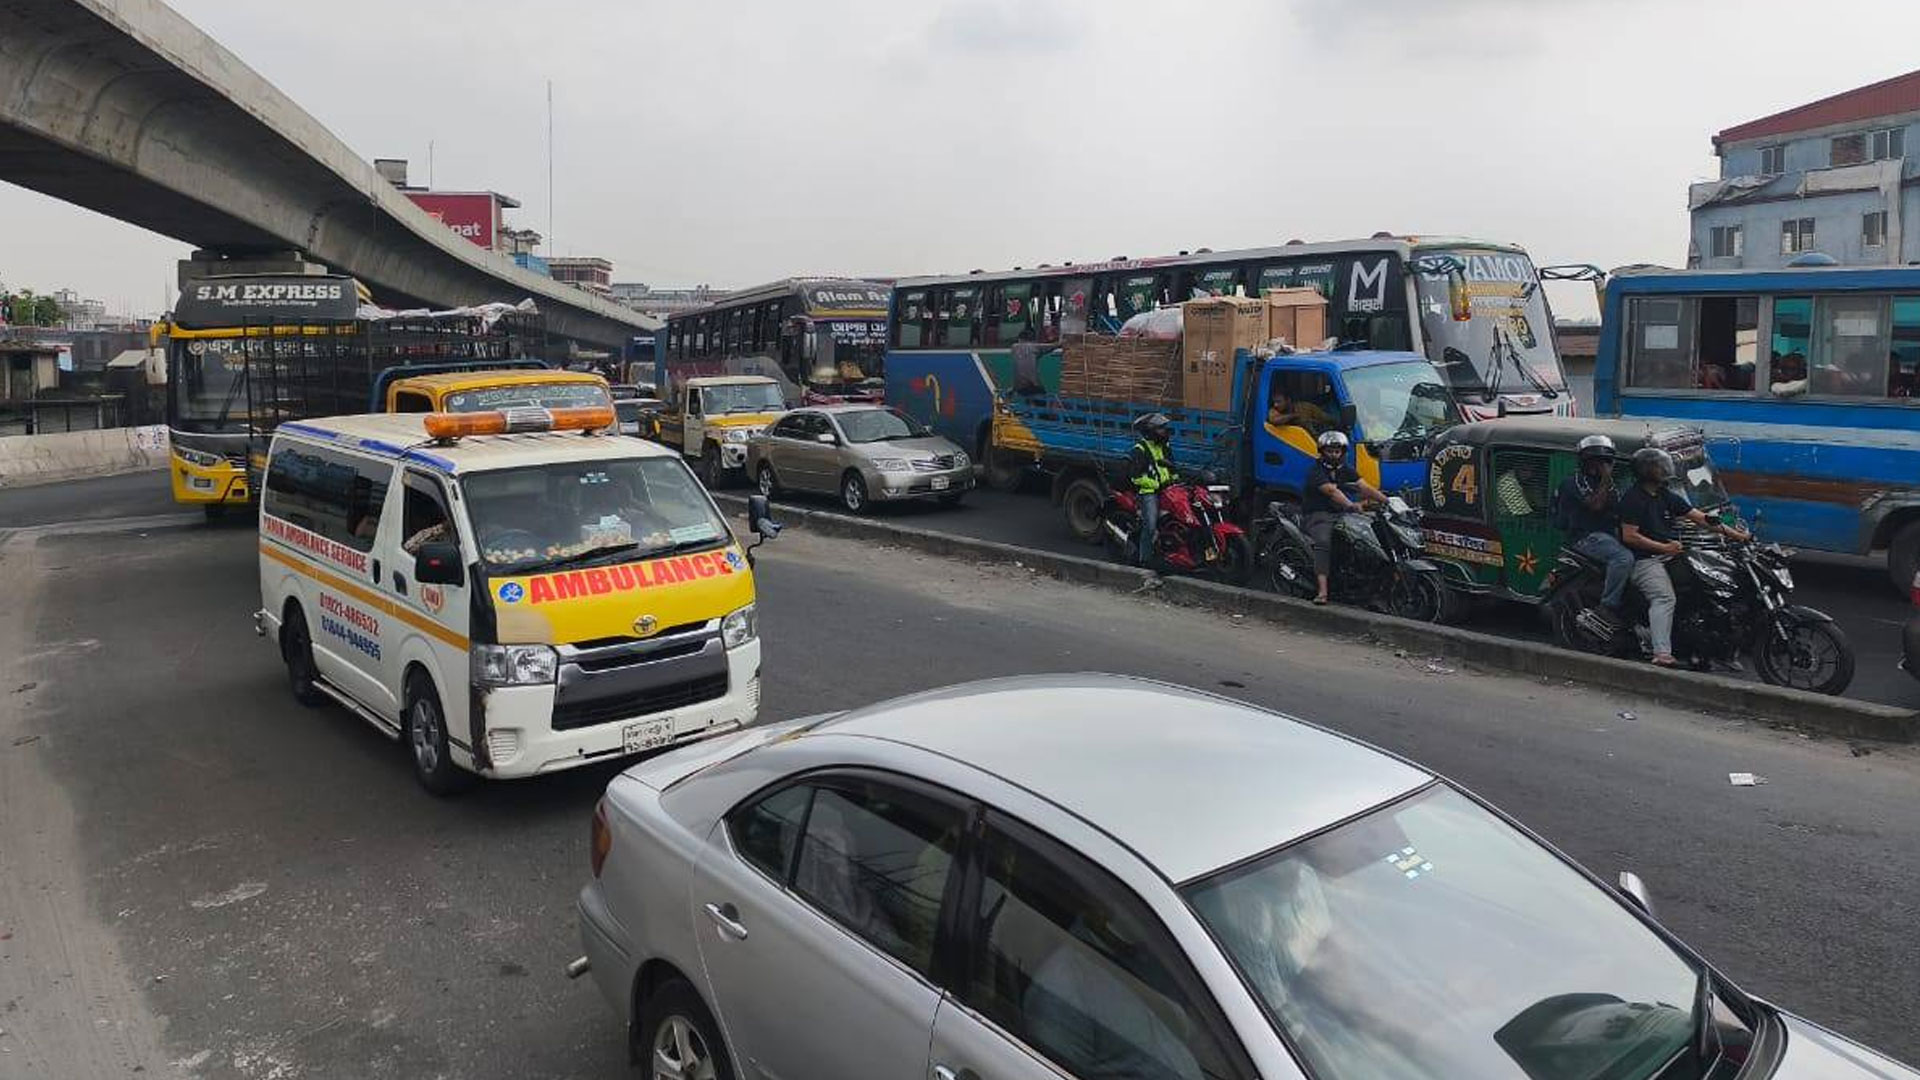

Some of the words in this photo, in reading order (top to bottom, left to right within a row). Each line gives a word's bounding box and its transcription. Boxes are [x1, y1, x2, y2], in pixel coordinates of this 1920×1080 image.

[197, 285, 237, 300] S.M
[243, 285, 343, 300] EXPRESS
[1452, 464, 1478, 504] 4
[530, 550, 732, 604] AMBULANCE
